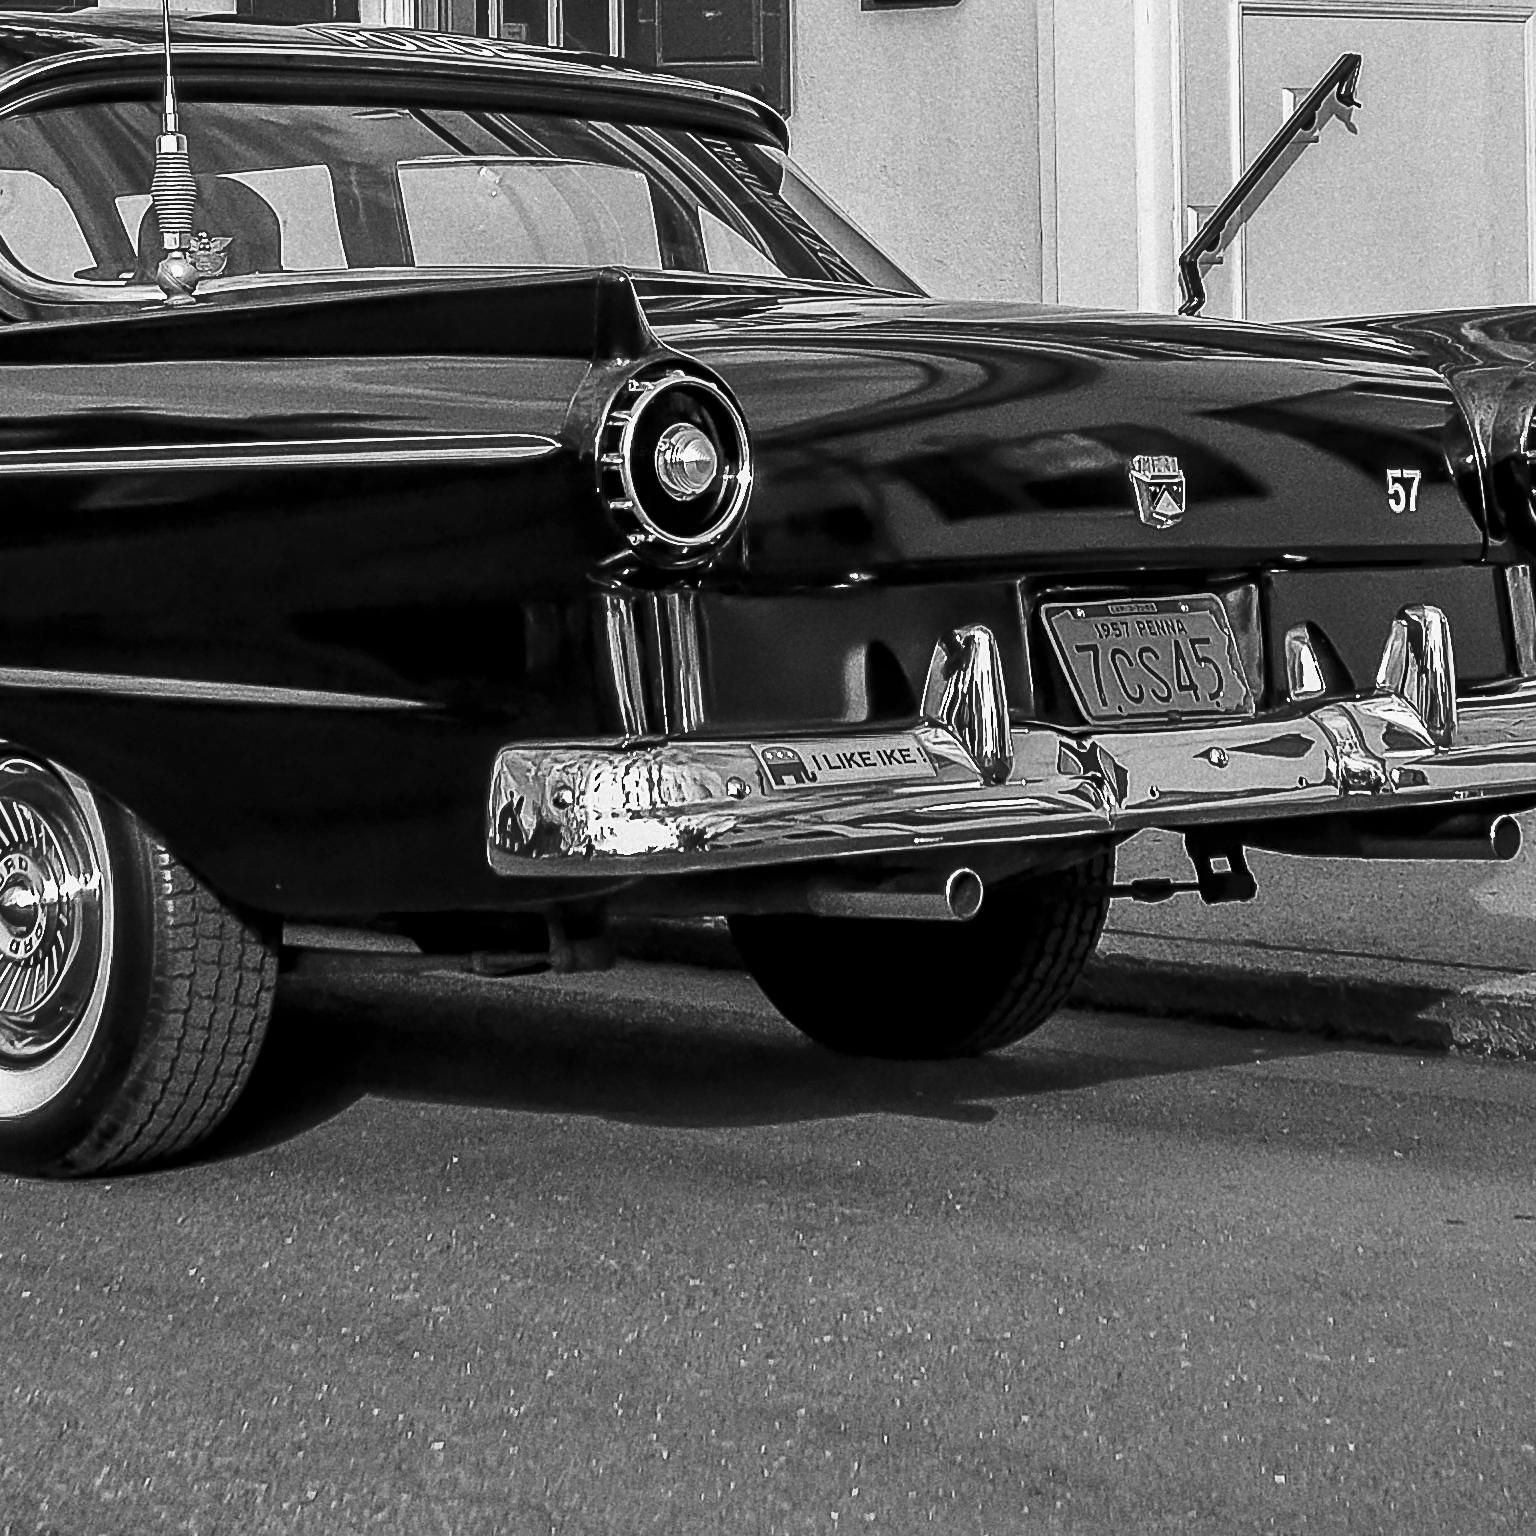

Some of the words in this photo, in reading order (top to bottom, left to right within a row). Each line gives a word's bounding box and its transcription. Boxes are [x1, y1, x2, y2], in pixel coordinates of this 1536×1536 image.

[1386, 468, 1421, 513] 57
[1094, 621, 1129, 639] 1957
[1135, 619, 1188, 637] PENNA
[1074, 637, 1225, 707] 7CS45
[811, 754, 822, 771] I
[822, 750, 877, 770] LIKE
